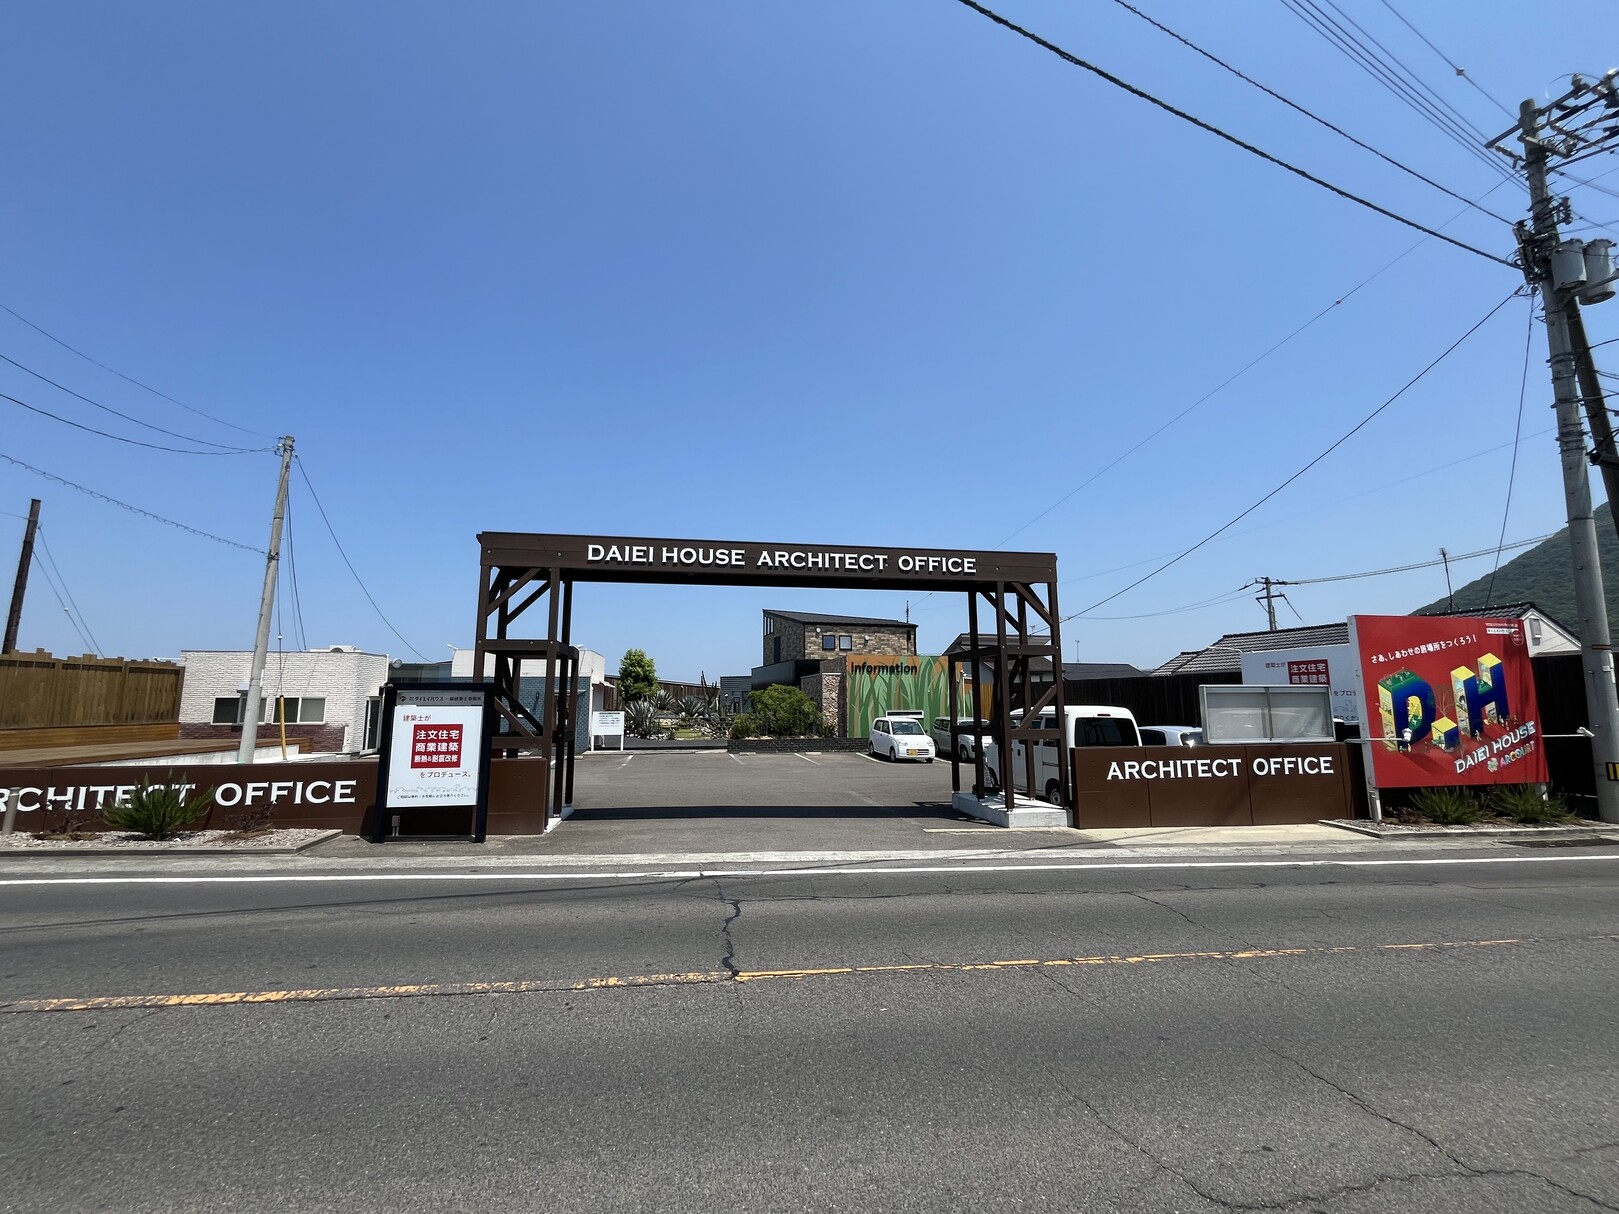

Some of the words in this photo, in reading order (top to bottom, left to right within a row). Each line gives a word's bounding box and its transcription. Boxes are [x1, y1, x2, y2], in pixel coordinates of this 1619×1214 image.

[587, 544, 654, 563] DAIEI
[662, 547, 745, 566] HOUSE
[757, 550, 888, 571] ARCHITECT
[898, 555, 977, 574] OFFICE
[1290, 663, 1326, 673] 注文住宅
[1291, 674, 1328, 684] 商業建築
[403, 714, 432, 722] 建築士が
[416, 730, 460, 740] 注文住宅
[415, 742, 459, 753] 商業建築
[1454, 743, 1490, 774] DAIEI
[1492, 720, 1537, 754] HOUSE
[1500, 740, 1535, 768] ARCOURT
[1106, 759, 1242, 780] ARCHITECT
[1252, 756, 1334, 776] OFFICE
[420, 771, 471, 779] をプロデュース。
[215, 780, 357, 807] OFFICE
